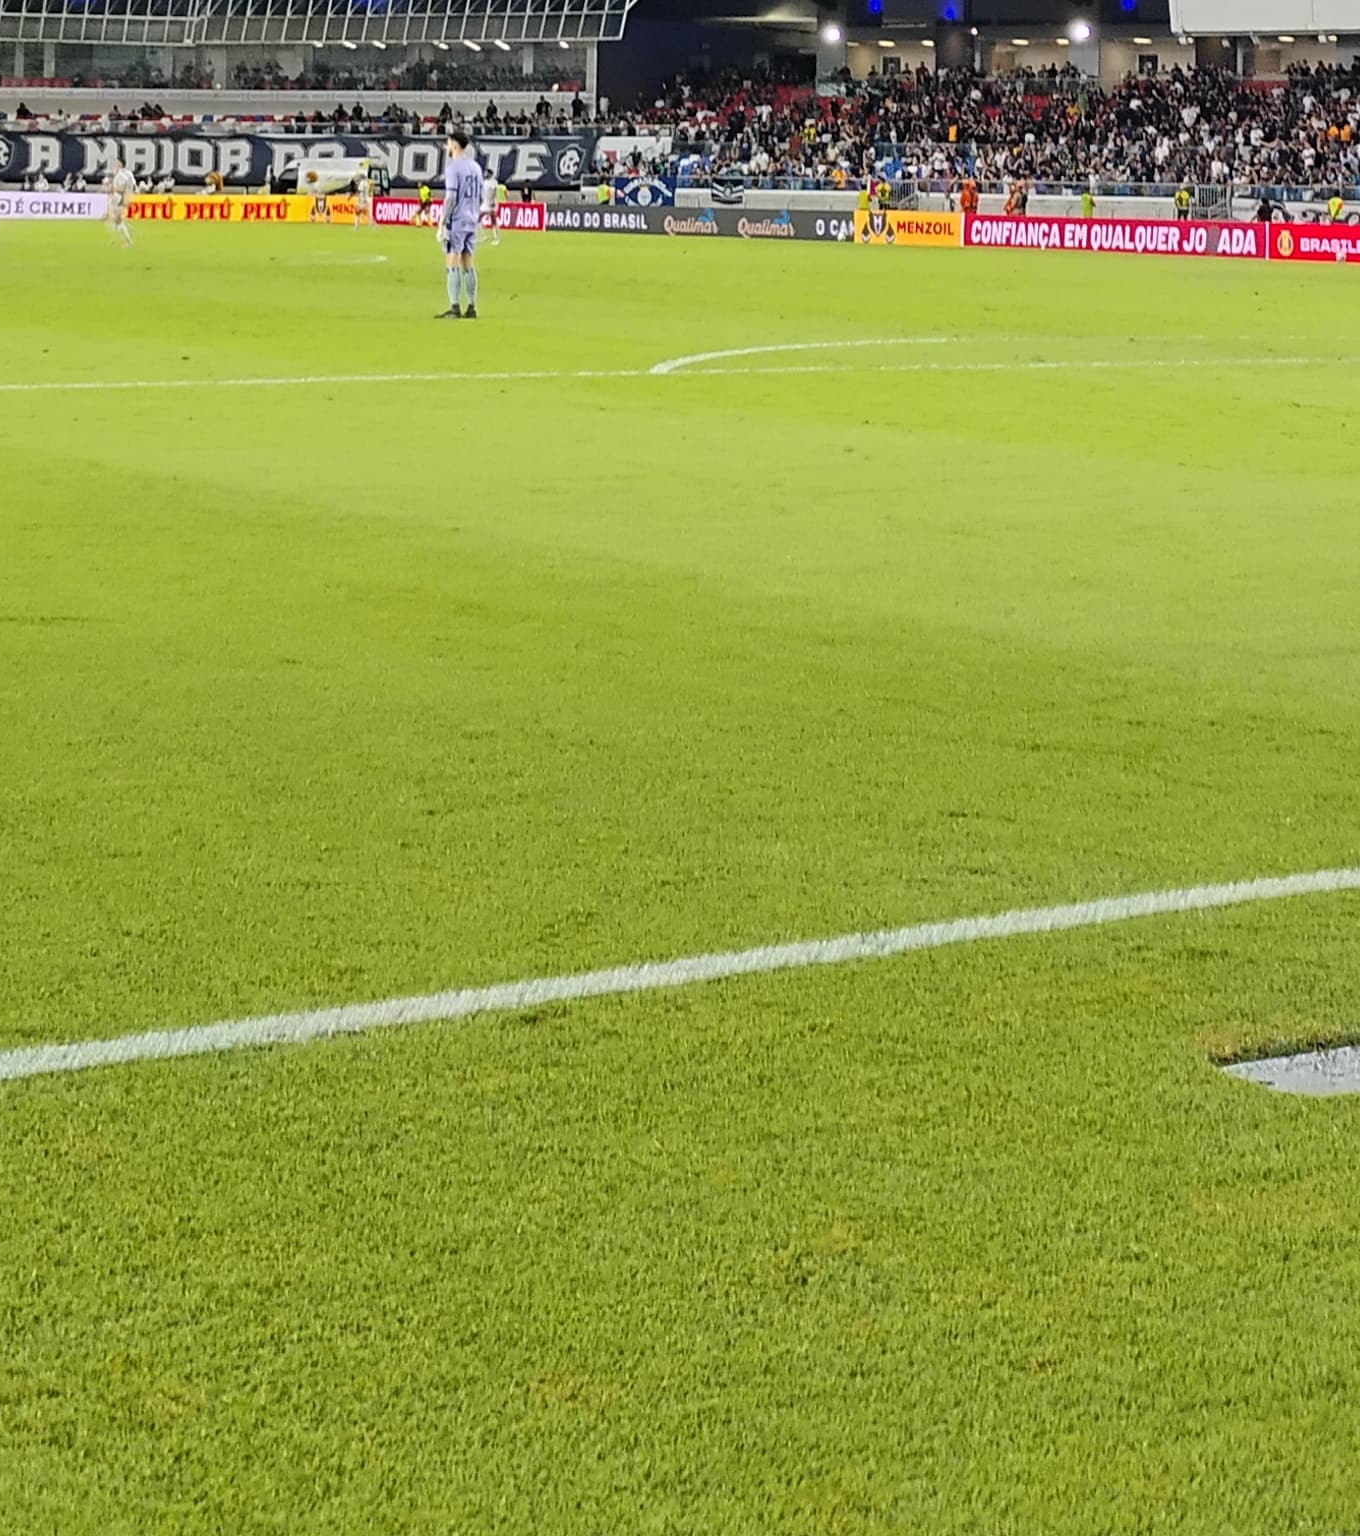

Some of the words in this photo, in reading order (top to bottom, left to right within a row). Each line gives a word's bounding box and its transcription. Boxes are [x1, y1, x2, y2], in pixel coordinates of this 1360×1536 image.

[25, 135, 63, 175] A
[81, 134, 252, 180] MAIOR
[366, 139, 552, 182] NOTE
[465, 175, 482, 198] 31
[15, 199, 24, 214] É
[34, 201, 91, 215] CRIME!
[127, 198, 175, 220] PITÚ
[185, 198, 232, 221] PITÚ
[242, 198, 289, 221] PITÚ
[583, 212, 601, 228] DO
[604, 212, 648, 230] BRASIL
[663, 215, 719, 236] Qualimar
[738, 217, 796, 239] Qualimar
[815, 219, 825, 236] O
[896, 221, 955, 236] MENZOIL
[971, 219, 1060, 250] CONFIANÇA
[1064, 224, 1087, 249] EM
[1090, 225, 1181, 254] QUALQUER
